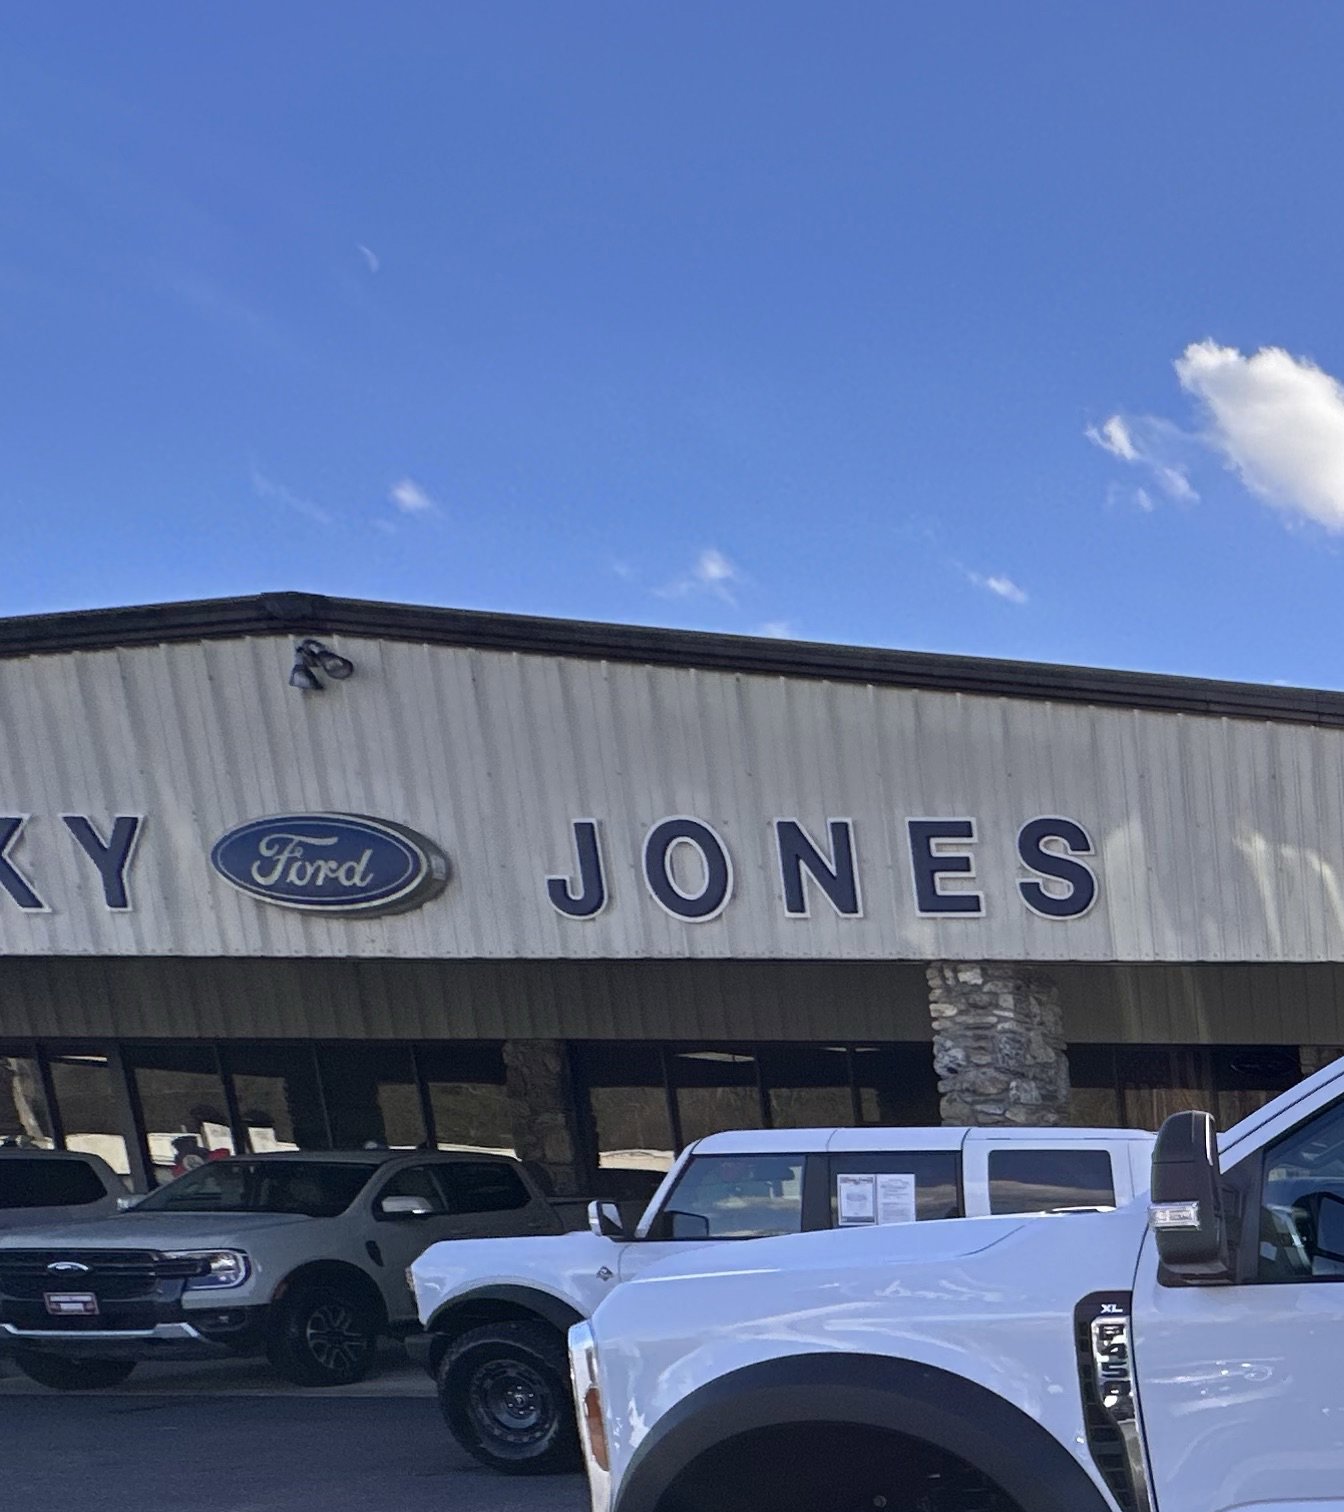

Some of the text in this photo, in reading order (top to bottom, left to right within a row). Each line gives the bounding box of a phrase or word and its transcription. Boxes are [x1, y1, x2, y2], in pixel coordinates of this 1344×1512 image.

[251, 833, 375, 888] Ford
[545, 815, 1099, 922] JONES
[1100, 1303, 1123, 1314] XL
